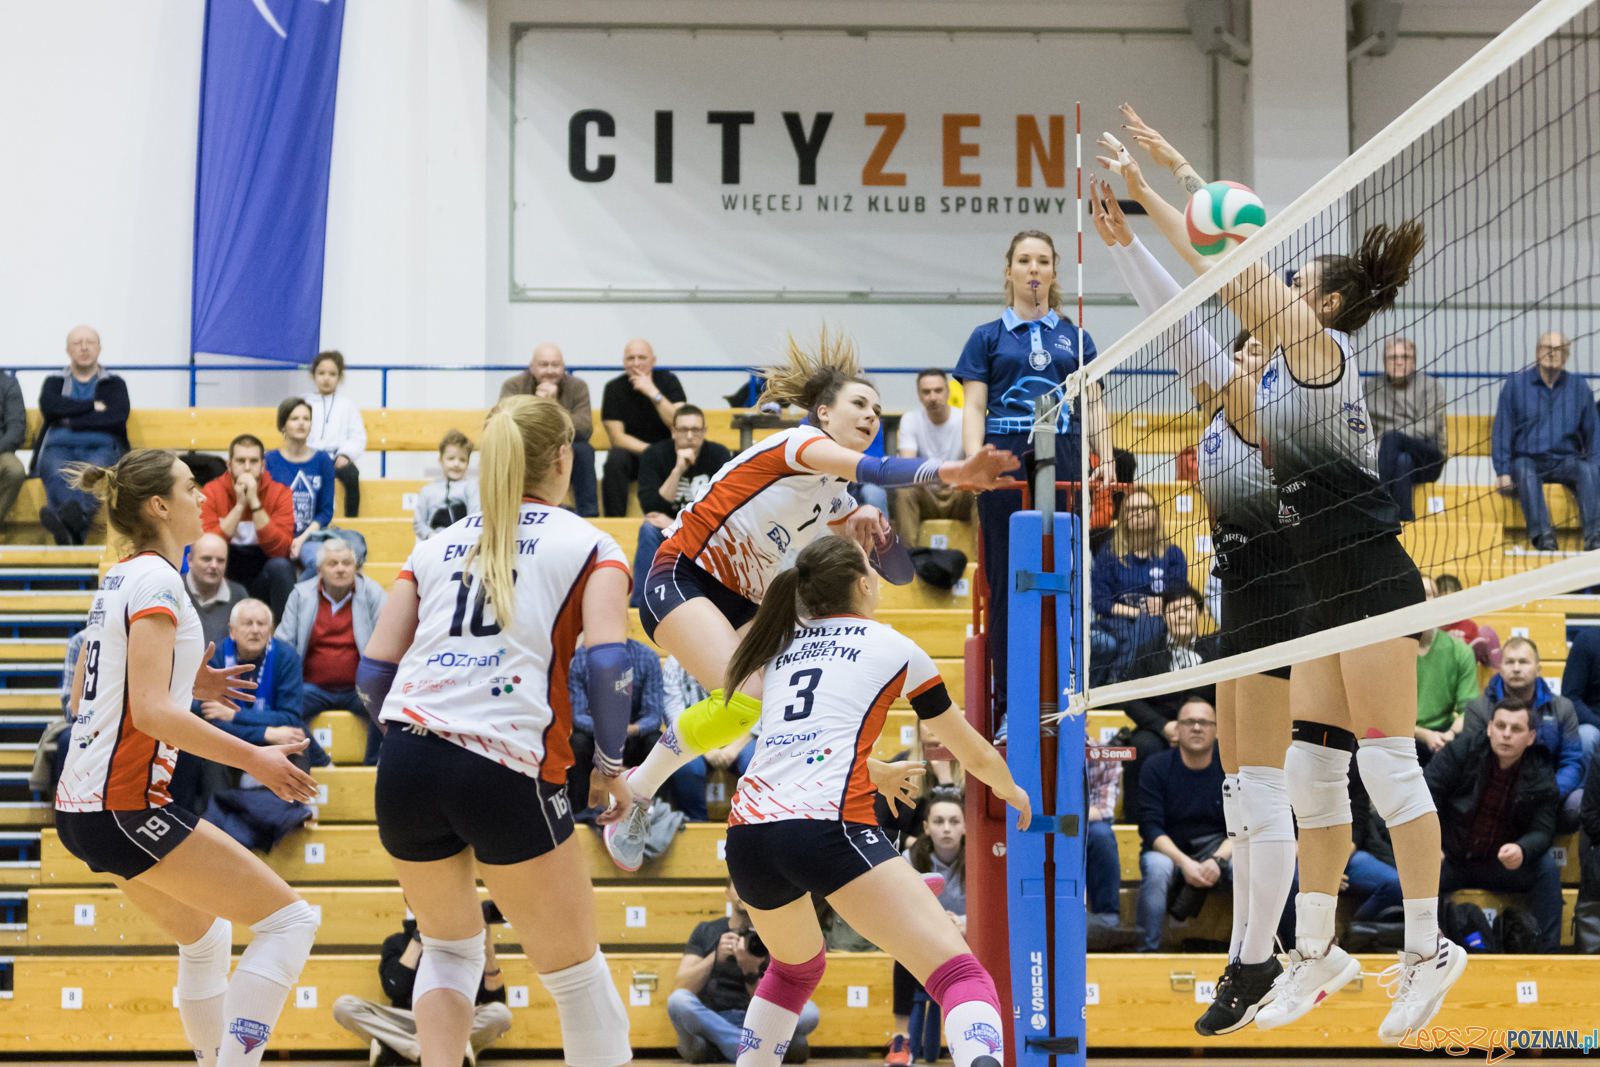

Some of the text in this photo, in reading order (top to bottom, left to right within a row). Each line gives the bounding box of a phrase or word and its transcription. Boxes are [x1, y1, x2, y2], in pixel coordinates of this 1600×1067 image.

[568, 108, 1065, 188] CITYZEN
[721, 194, 802, 215] WIĘCEJ
[867, 195, 926, 213] KLUB
[940, 196, 1066, 214] SPORTOWY
[654, 584, 666, 601] 7
[801, 640, 836, 651] ENEA
[775, 646, 862, 671] ENERGETYK
[783, 667, 824, 722] 3
[1101, 748, 1132, 759] Senoh
[135, 815, 171, 842] 19
[860, 829, 879, 845] 3
[1521, 985, 1532, 996] 11
